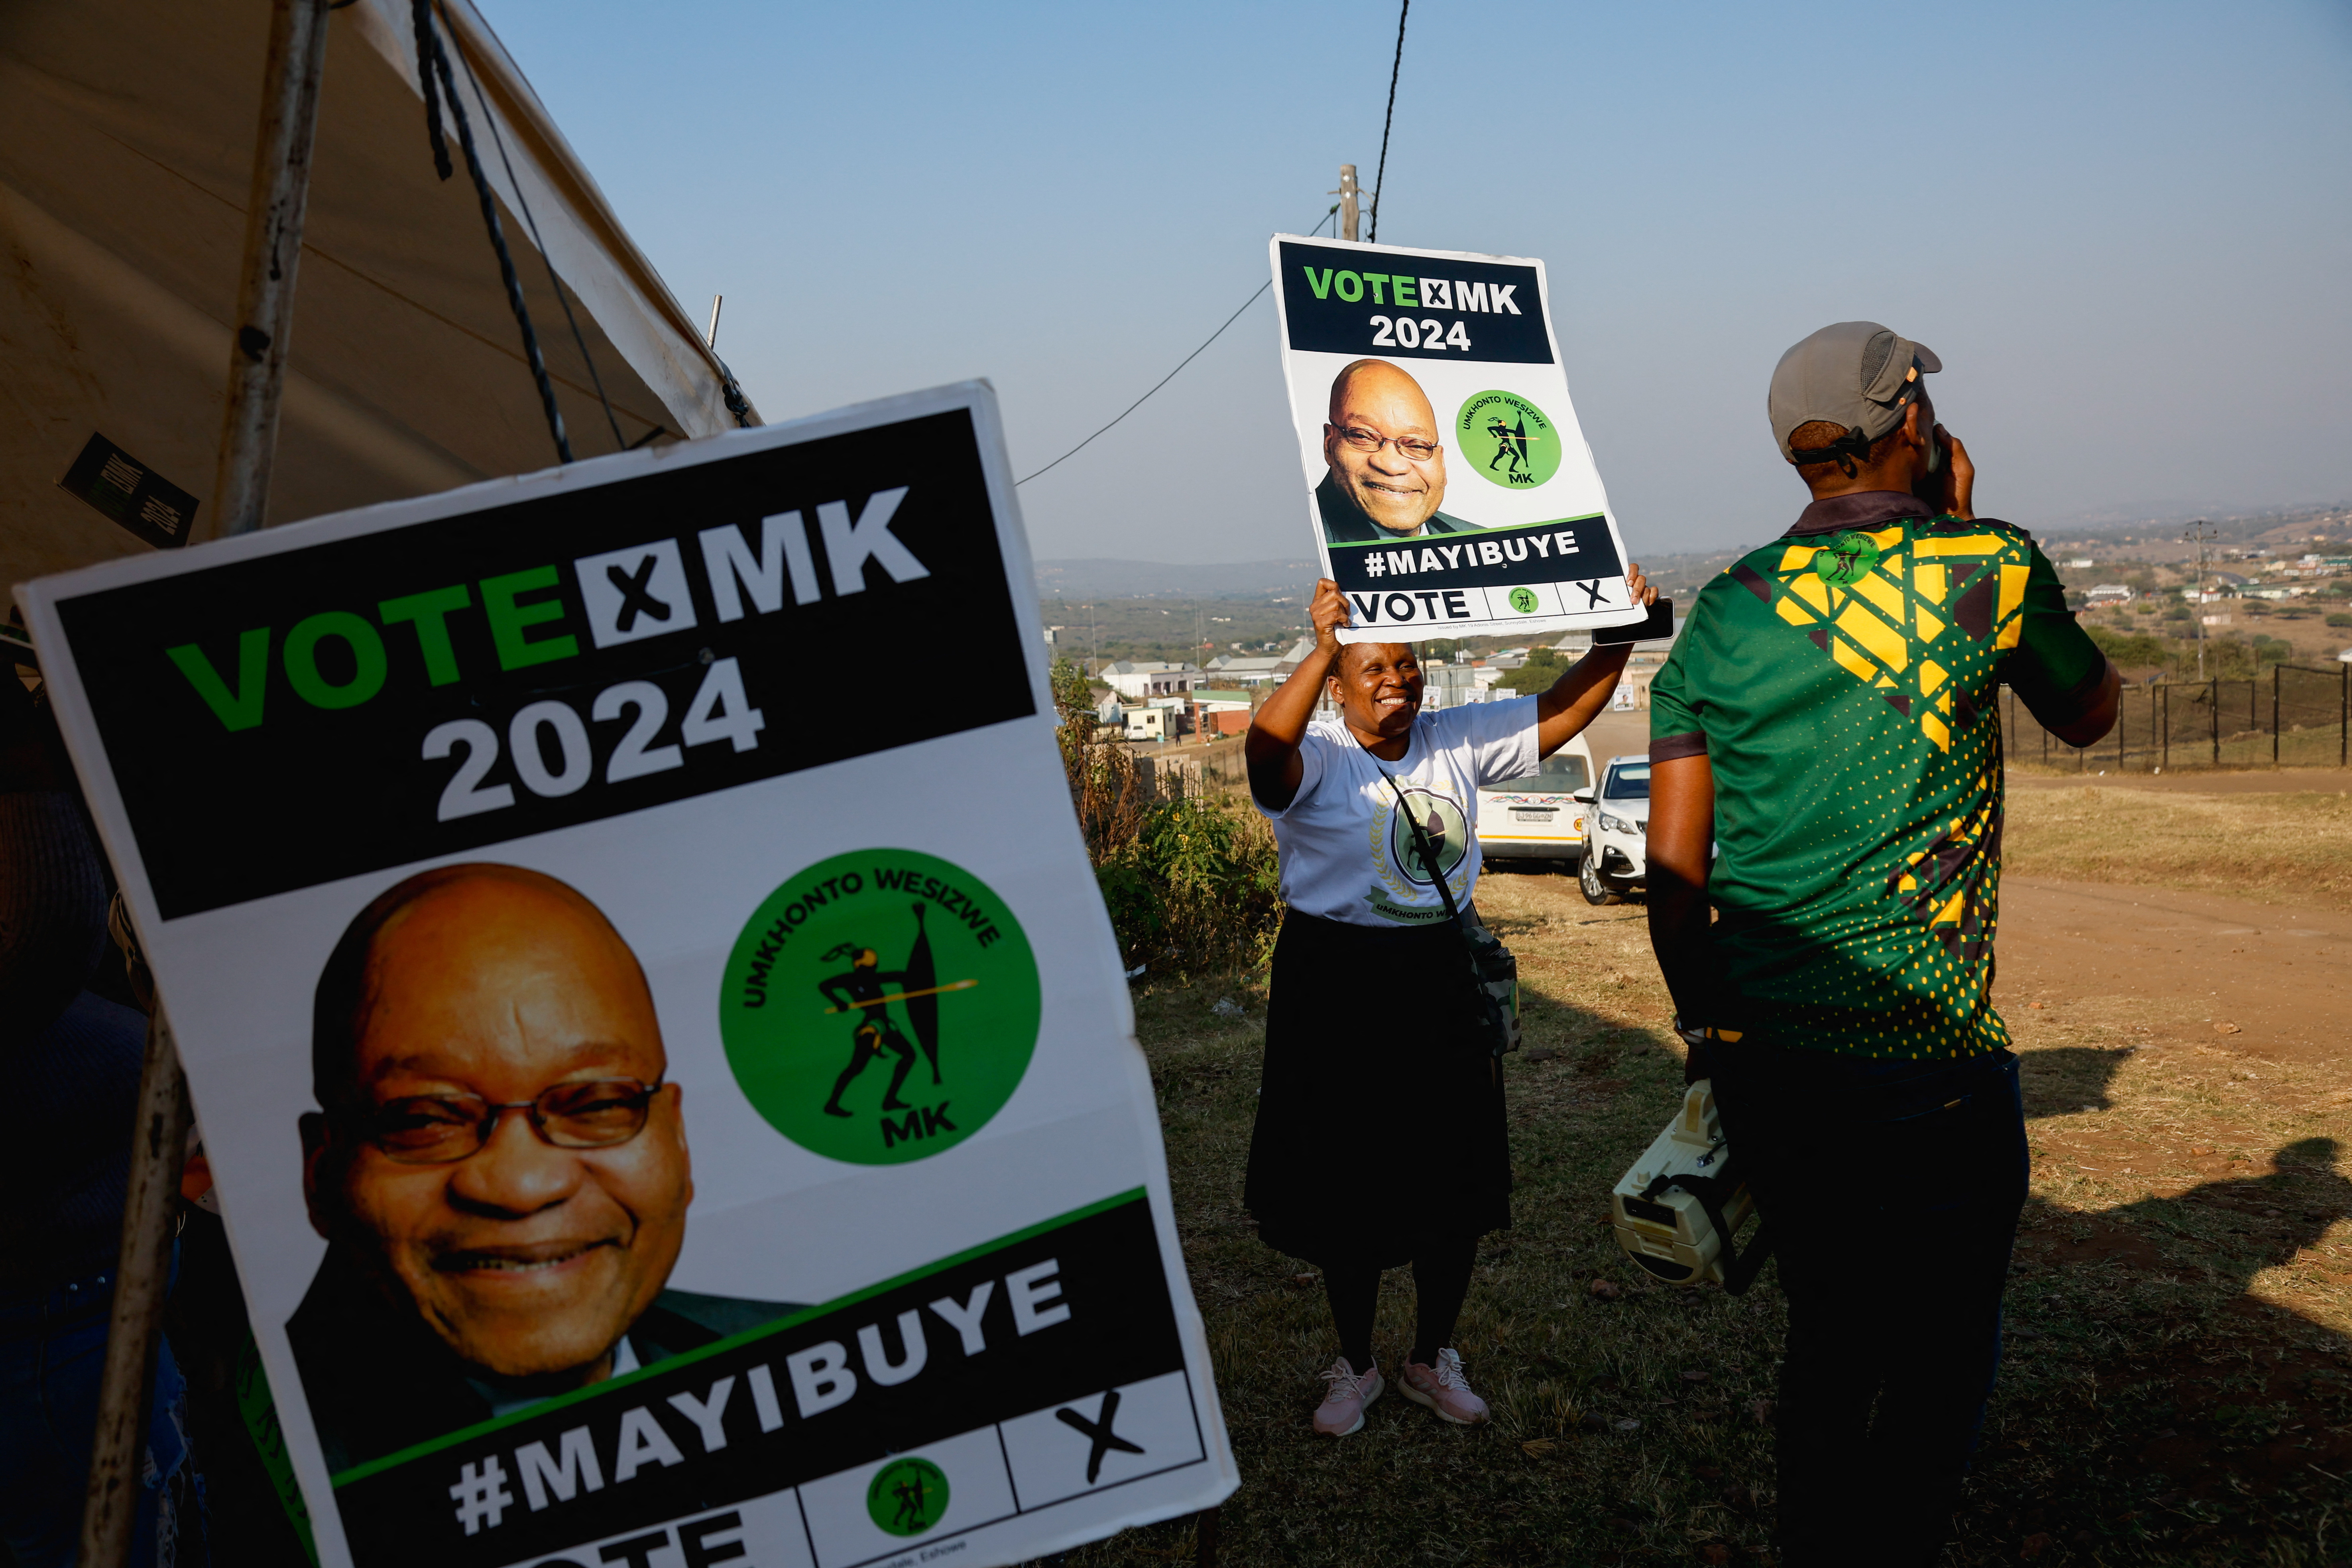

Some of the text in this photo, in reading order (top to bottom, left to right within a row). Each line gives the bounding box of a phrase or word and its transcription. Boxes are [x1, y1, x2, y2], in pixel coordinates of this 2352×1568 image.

[1304, 266, 1419, 307] VOTE
[1455, 281, 1522, 315] MK
[1370, 315, 1471, 351] 2024
[1463, 396, 1547, 430] UMKHONTO WESIZWE
[1508, 473, 1535, 484] MK
[140, 495, 181, 535] 2024
[1365, 531, 1579, 577] #MAYIBUYE
[1850, 533, 1875, 548] WESIZWE
[166, 564, 580, 732] VOTE
[698, 486, 930, 622] MK
[1351, 590, 1471, 623] VOTE
[423, 657, 765, 821] 2024
[1377, 904, 1433, 919] uMKHONTO
[744, 868, 1000, 1008] UMKHONTO WESIZWE
[881, 1101, 956, 1148] MK
[450, 1258, 1070, 1535] #MAYIBUYE
